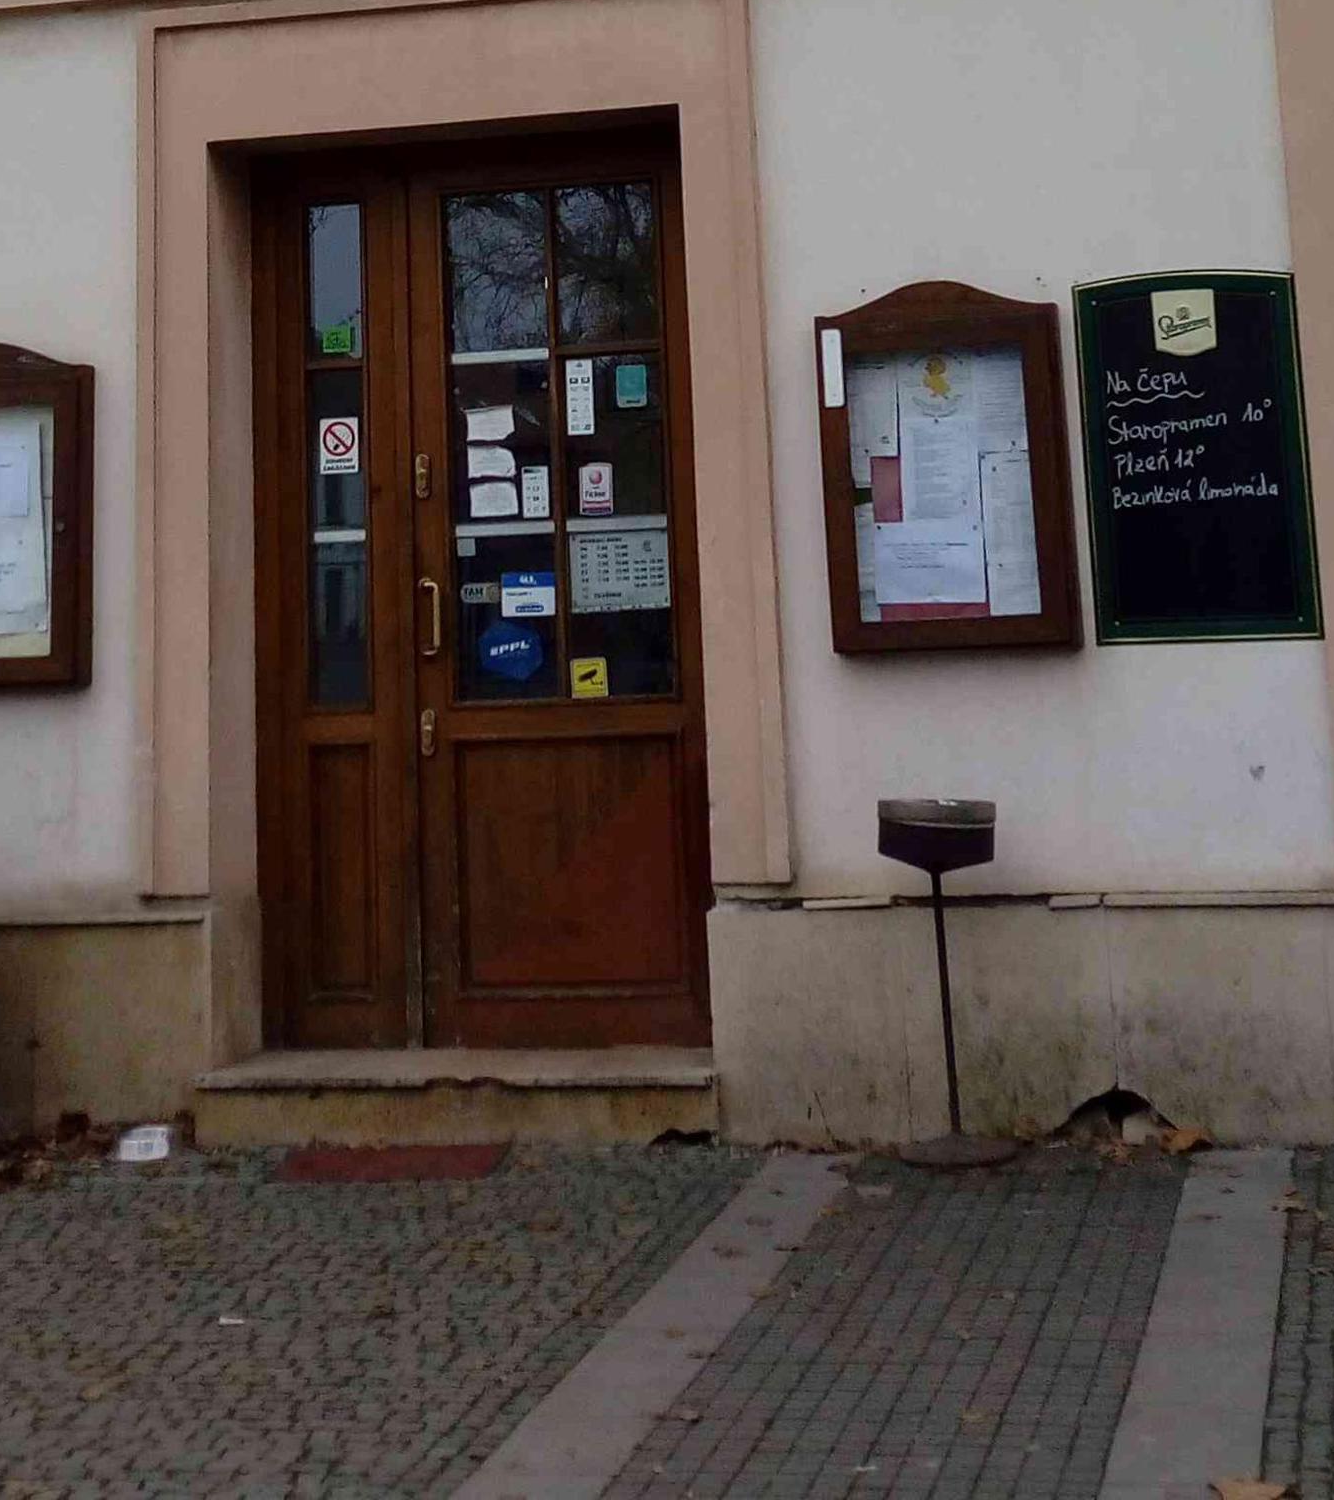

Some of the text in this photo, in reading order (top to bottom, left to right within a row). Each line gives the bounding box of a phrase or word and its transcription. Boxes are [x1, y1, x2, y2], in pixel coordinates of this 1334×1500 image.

[1106, 370, 1131, 396] Na
[1108, 414, 1228, 445] Staropramen
[1199, 472, 1279, 501] limonáda
